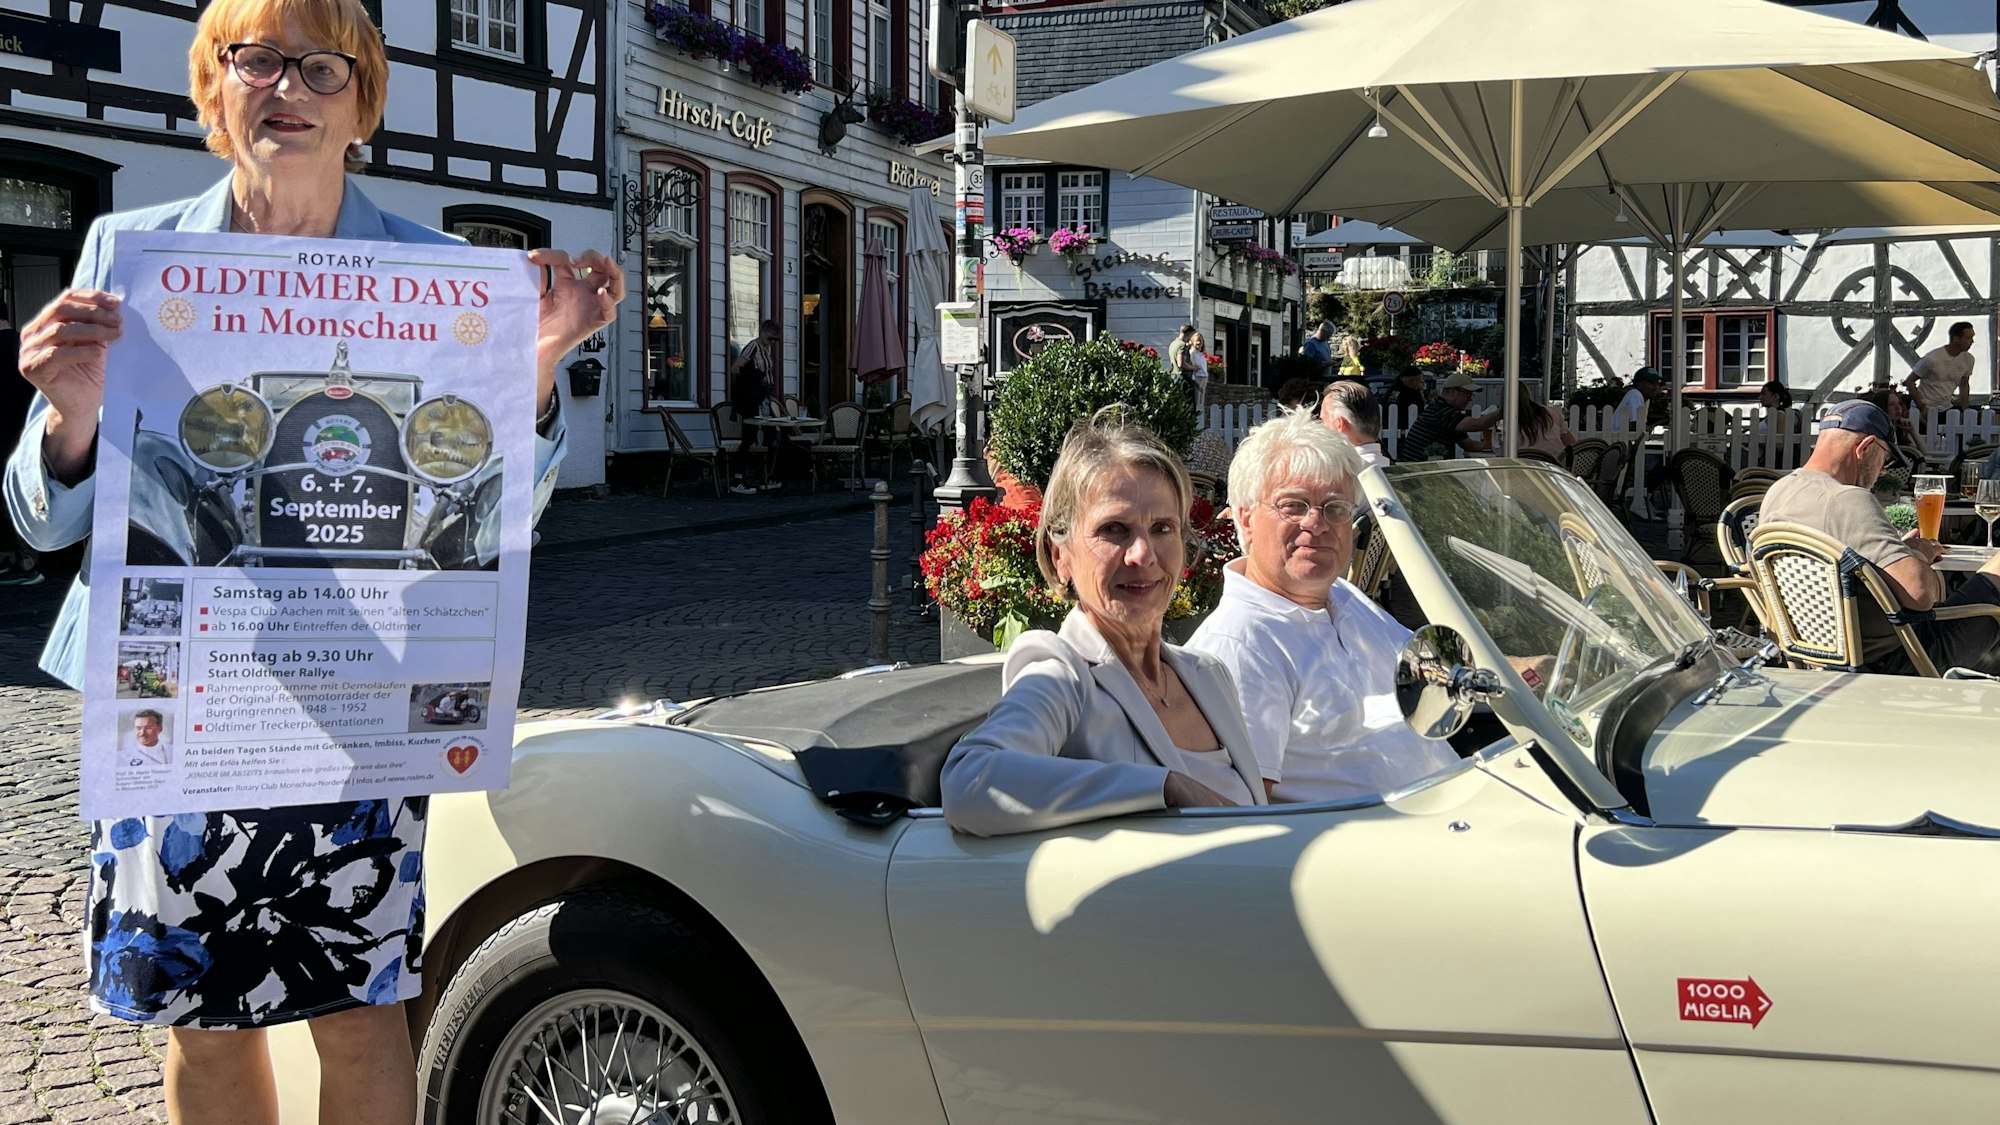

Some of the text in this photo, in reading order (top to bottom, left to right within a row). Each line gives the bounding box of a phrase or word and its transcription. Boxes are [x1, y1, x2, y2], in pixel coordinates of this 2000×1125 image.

[657, 86, 774, 150] Hirsch-Café
[974, 175, 983, 184] 35
[298, 252, 375, 268] ROTARY
[787, 261, 793, 274] 3
[161, 265, 489, 308] OLDTIMER DAYS
[1083, 280, 1183, 300] Bäckerei
[211, 304, 438, 342] in Monschau
[300, 474, 373, 494] 6. + 7.
[270, 498, 402, 522] September
[306, 524, 364, 543] 2025
[213, 586, 389, 602] Samstag ab 14.00 Uhr
[212, 606, 247, 618] Vespa
[250, 606, 277, 616] Club
[280, 606, 322, 616] Aachen
[326, 606, 345, 616] mit
[349, 607, 384, 617] seinen
[212, 621, 422, 632] ab 16.00 Uhr Eintreffen der Oldtimer
[209, 649, 374, 666] Sonntag ab 9.30 Uhr
[208, 668, 336, 679] Start Oldtimer Rallye
[206, 681, 406, 695] Rahmenprogramme mit Demoläufen
[206, 691, 392, 706] der Original-Rennmotorräder der
[206, 706, 296, 719] Burgringrennen
[302, 704, 327, 714] 1948
[342, 703, 368, 713] 1952
[205, 717, 384, 732] Oldtimer Treckerpräsentationen
[185, 737, 441, 756] An beiden Tagen Stände mit Getränken, Imbiss, Kuchen
[200, 760, 218, 768] dem
[220, 758, 240, 766] Erlös
[242, 758, 266, 766] helfen
[232, 769, 263, 777] ABSEITS
[264, 767, 300, 776] brauchen
[182, 786, 234, 794] Veranstalter:
[236, 784, 260, 792] Rotary
[1687, 983, 1745, 999] 1000
[1684, 1002, 1752, 1020] MIGLIA
[432, 980, 486, 1071] VREDESTEIN
